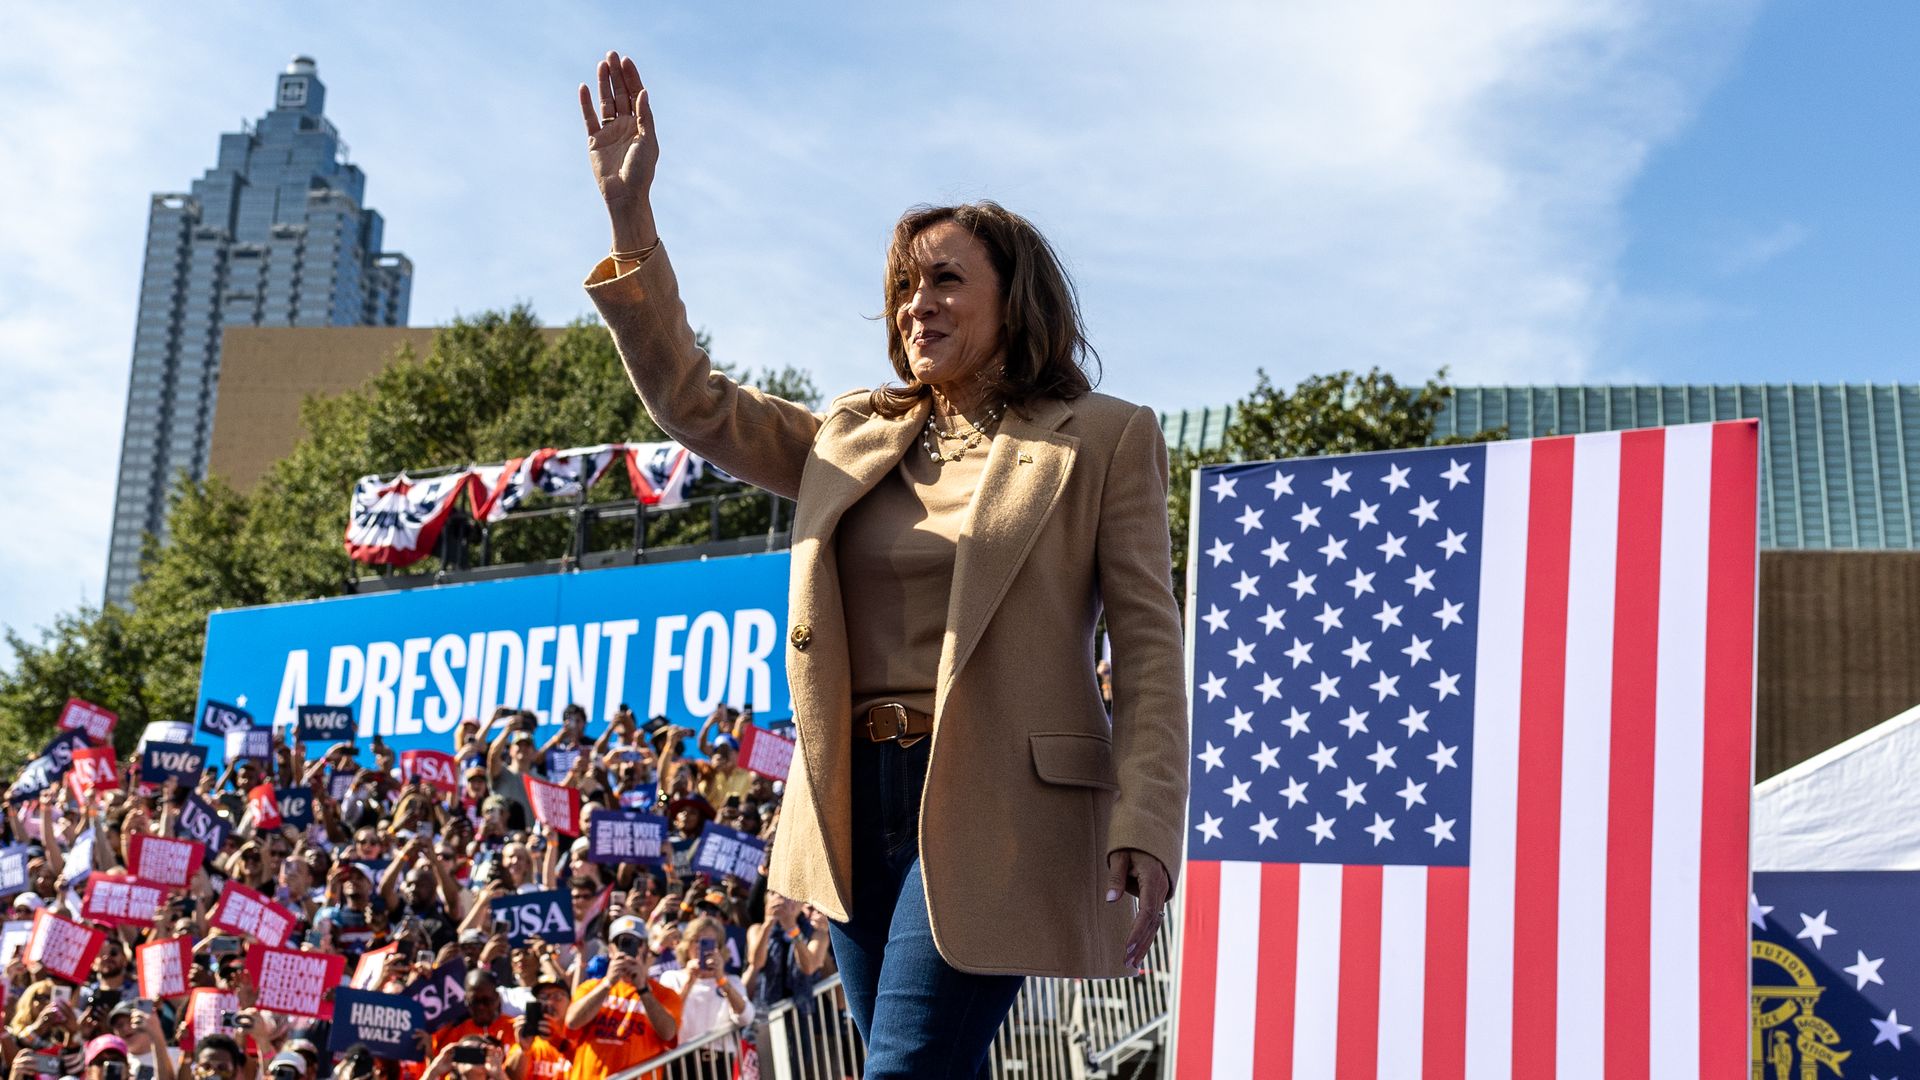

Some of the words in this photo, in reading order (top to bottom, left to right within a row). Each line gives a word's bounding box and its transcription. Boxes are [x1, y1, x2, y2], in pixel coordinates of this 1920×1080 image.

[273, 648, 309, 737] A
[325, 618, 639, 737] PRESIDENT
[648, 608, 777, 718] FOR
[304, 711, 349, 730] vote
[151, 750, 201, 773] vote
[402, 757, 456, 785] USA
[181, 801, 222, 851] USA
[612, 820, 633, 839] WE
[633, 821, 661, 841] VOTE
[613, 838, 634, 856] WE
[634, 839, 662, 857] WIN
[720, 837, 742, 857] WE
[715, 853, 738, 875] WE
[109, 883, 130, 899] WE
[107, 897, 128, 916] WE
[242, 898, 264, 919] WE
[238, 912, 260, 935] WE
[494, 901, 572, 938] USA
[261, 950, 327, 976] FREEDOM
[259, 969, 325, 995] FREEDOM
[256, 988, 323, 1014] FREEDOM
[413, 975, 466, 1020] SA
[351, 1002, 412, 1031] HARRIS
[358, 1026, 402, 1043] WALZ
